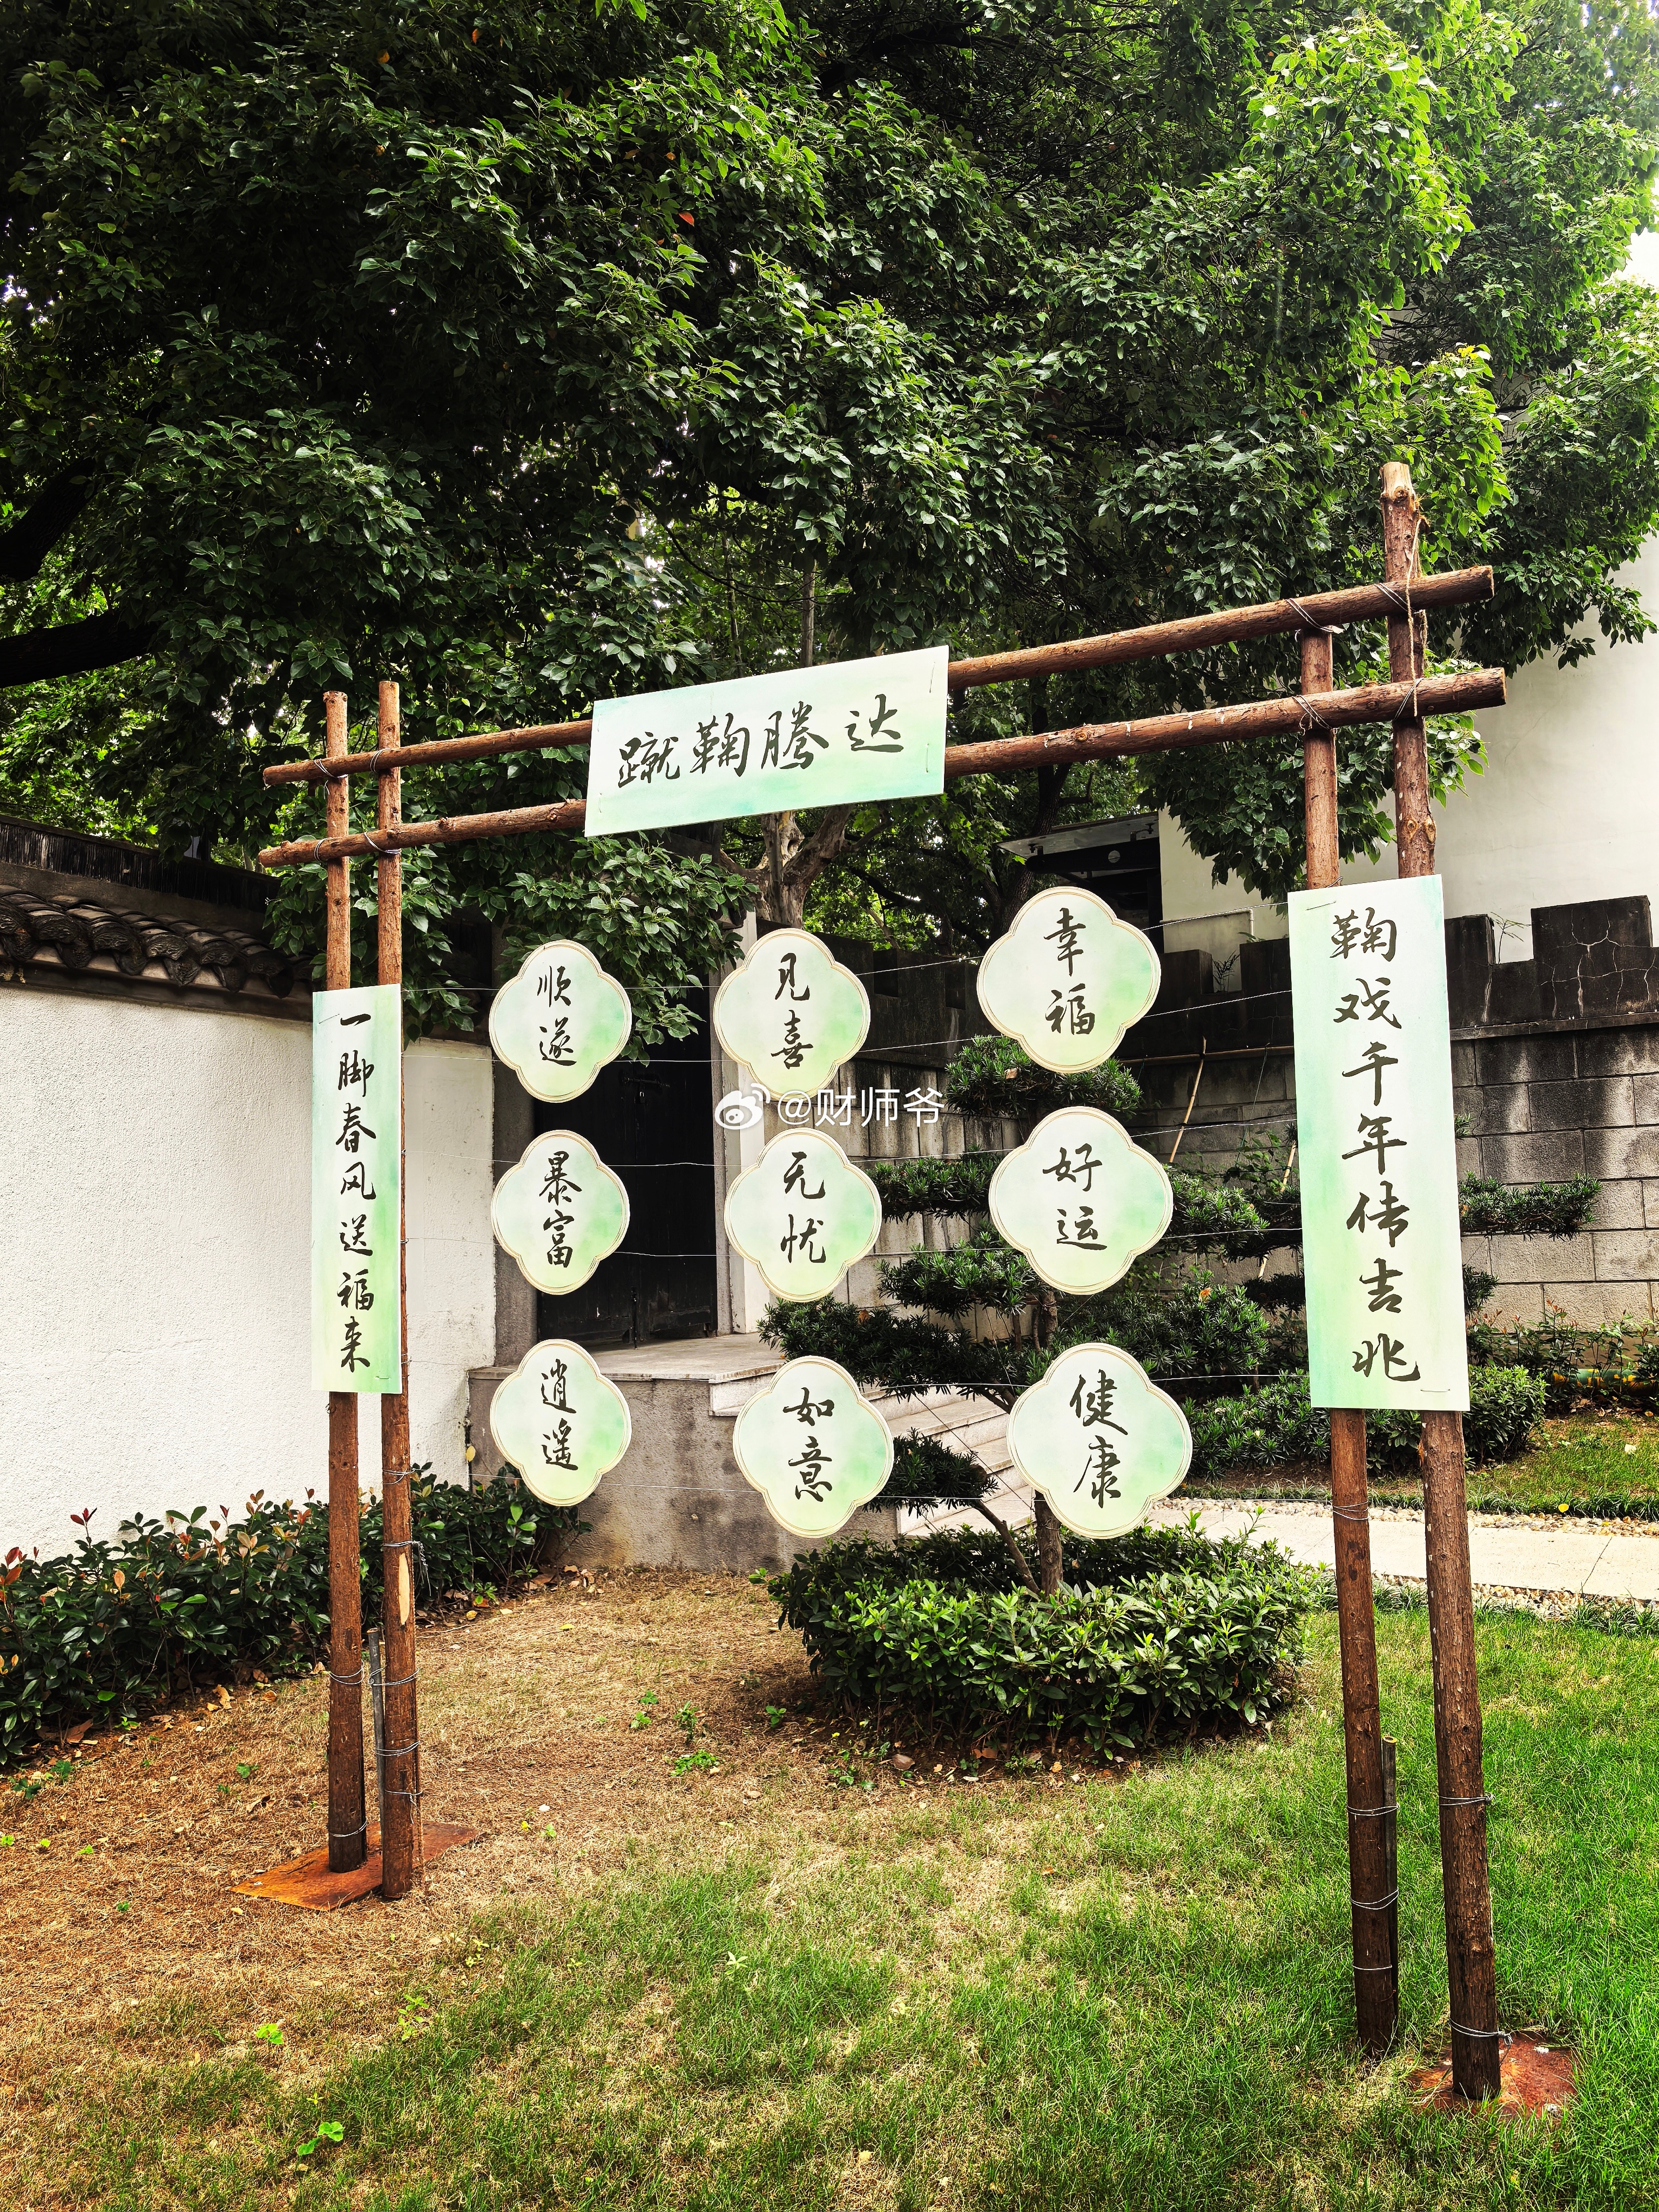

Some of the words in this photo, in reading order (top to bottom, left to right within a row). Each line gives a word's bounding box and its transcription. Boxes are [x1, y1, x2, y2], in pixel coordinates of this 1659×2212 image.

[618, 693, 904, 788] 蹴鞠腾达
[537, 966, 577, 1067] 顺遂
[771, 953, 814, 1070] 见喜
[1043, 907, 1095, 1035] 幸福
[335, 1013, 376, 1373] 一脚春风送福来
[1042, 1143, 1108, 1251] 好运
[1329, 907, 1421, 1382] 鞠戏千年传吉兆
[539, 1151, 583, 1268] 暴富
[780, 1151, 826, 1264] 无忧
[541, 1358, 578, 1471] 逍遥
[782, 1387, 835, 1502] 如意
[1069, 1368, 1128, 1509] 健康
